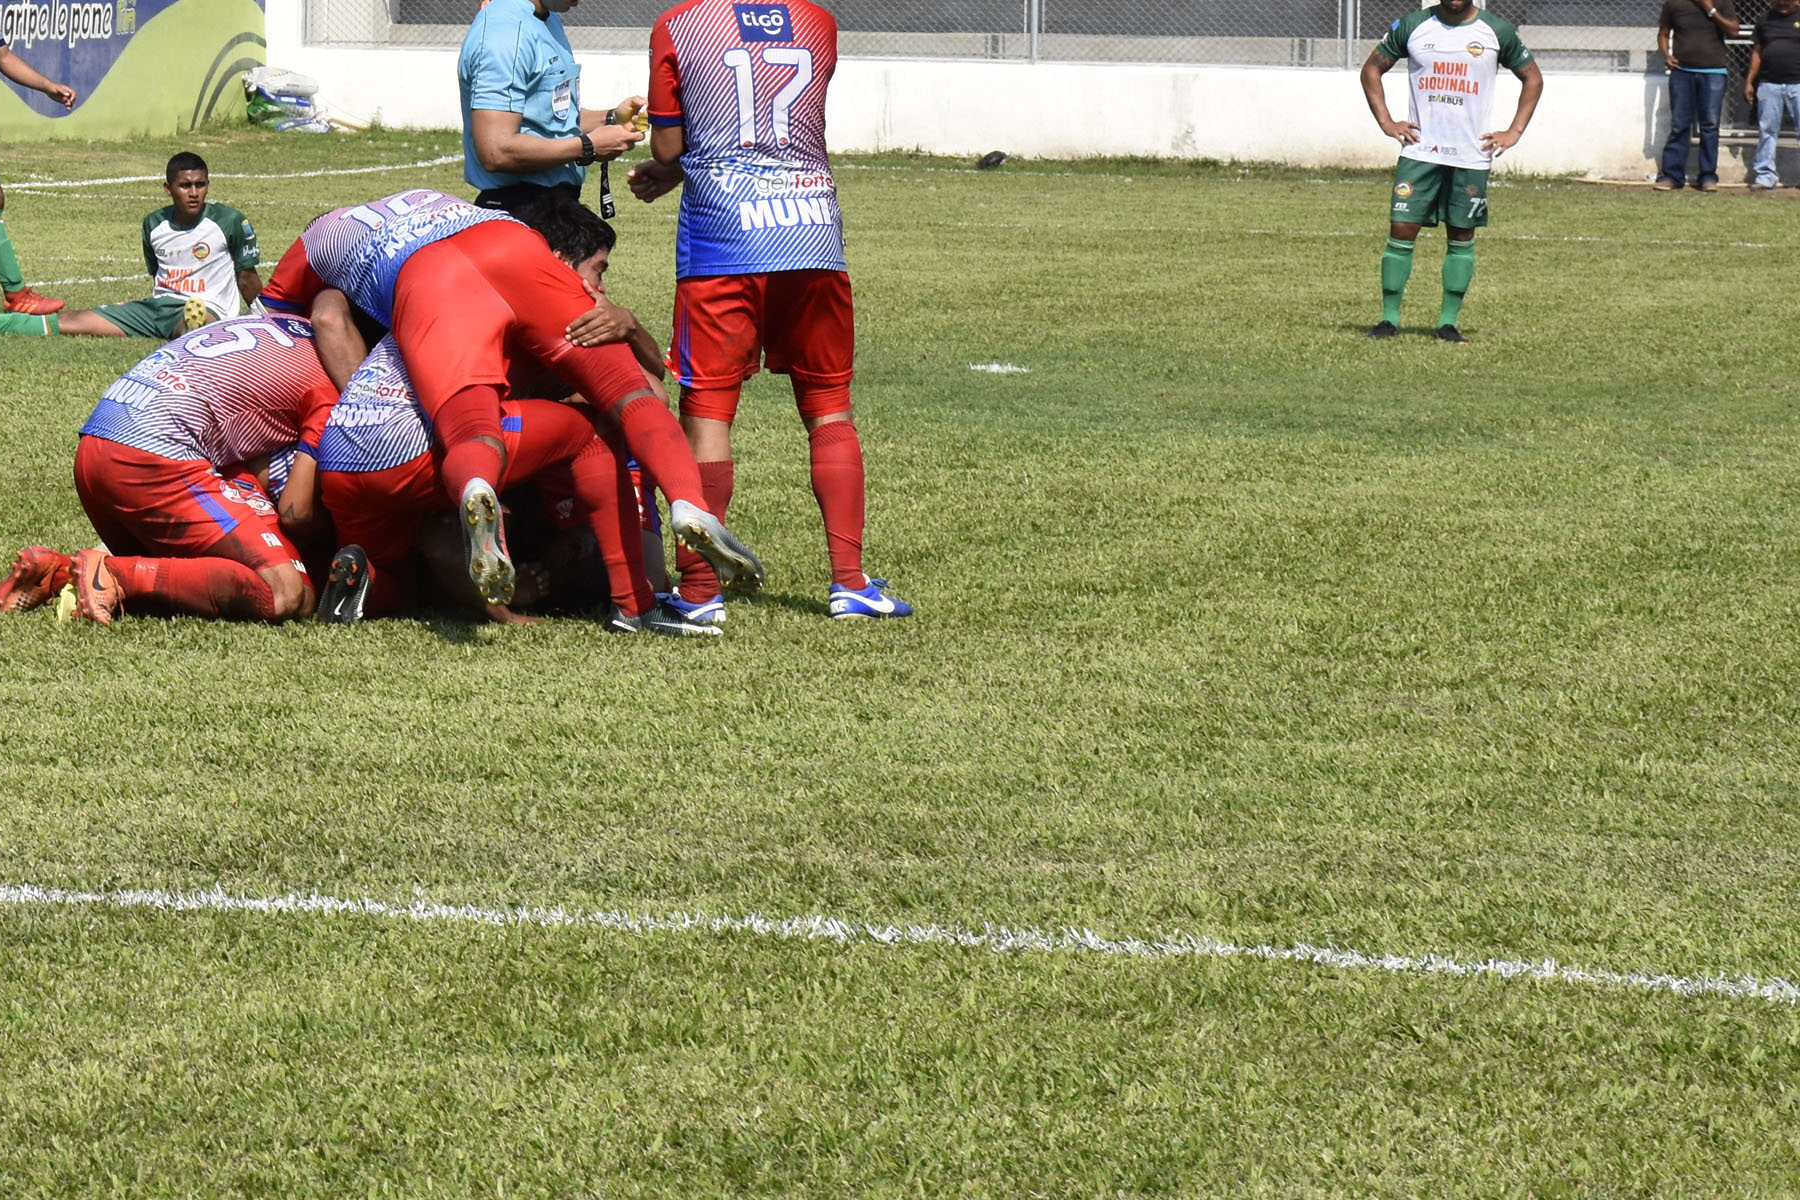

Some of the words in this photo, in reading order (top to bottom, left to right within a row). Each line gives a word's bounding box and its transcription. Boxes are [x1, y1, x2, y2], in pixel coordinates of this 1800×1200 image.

[70, 1, 113, 47] pone
[1433, 61, 1468, 76] MUNI
[722, 48, 813, 149] 17
[1418, 76, 1480, 96] SIQUINALA
[739, 197, 832, 231] MUNI
